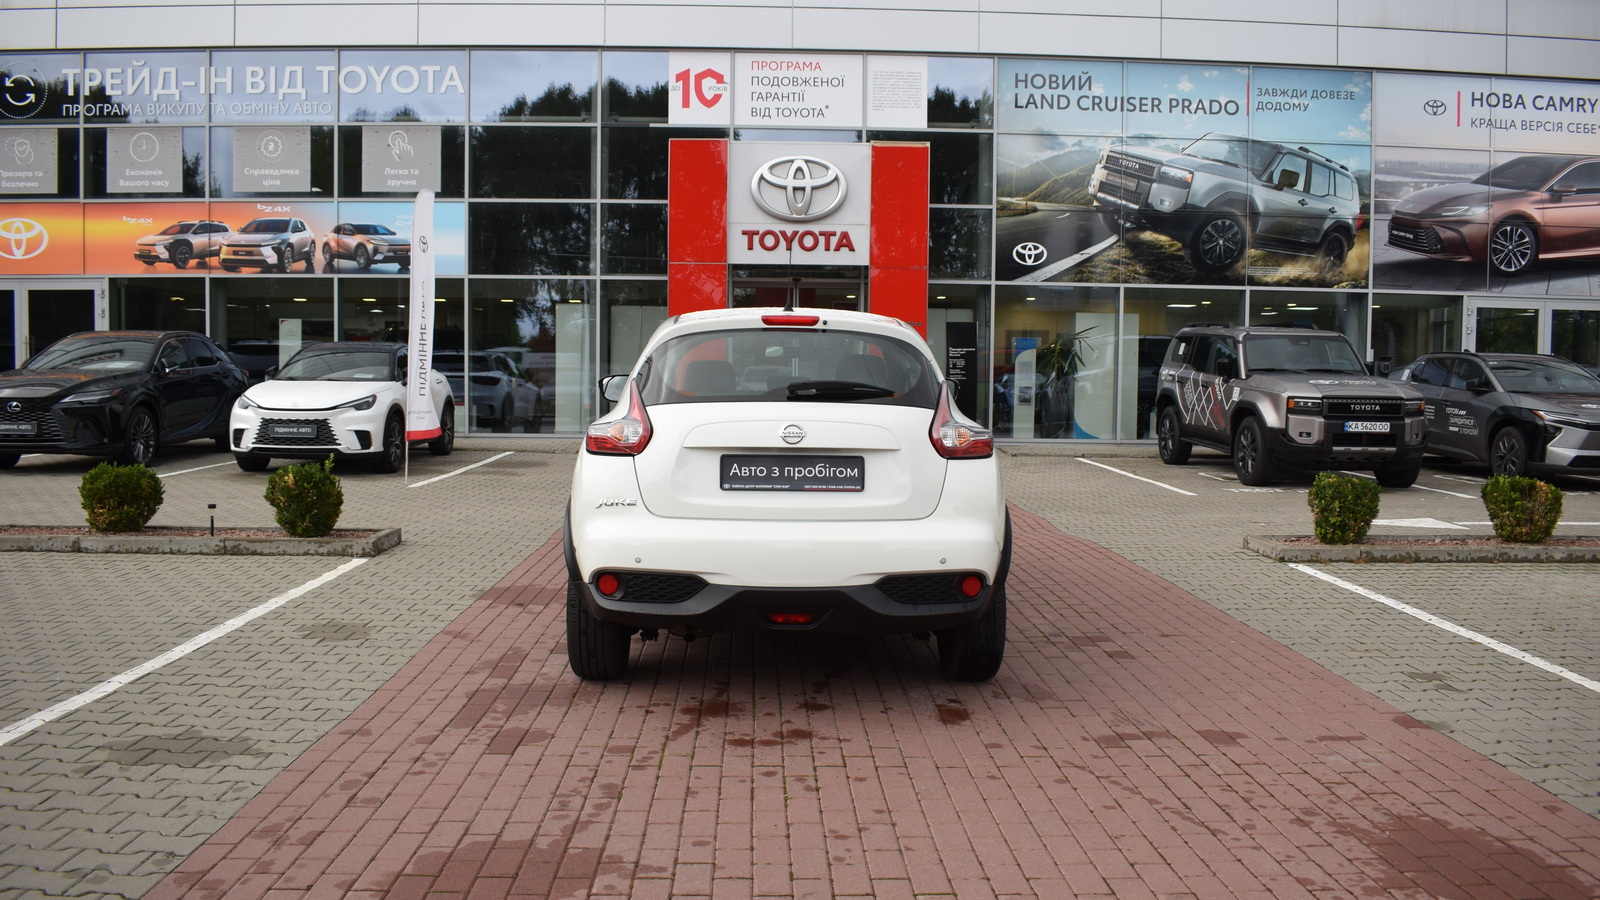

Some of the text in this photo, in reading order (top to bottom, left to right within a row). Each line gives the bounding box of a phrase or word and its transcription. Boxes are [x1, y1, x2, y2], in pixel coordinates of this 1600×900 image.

[751, 60, 822, 72] ПРОГРАМА
[61, 59, 465, 101] ТРЕЙД-ІН ВІД TOYOTA
[751, 74, 846, 88] ПОДОВЖЕНОЇ
[1014, 71, 1092, 91] НОВИЙ
[751, 89, 806, 102] ГАРАНТІЇ
[1256, 87, 1356, 100] ЗАВЖДИ ДОВЕЗЕ
[1014, 92, 1240, 116] LAND CRUISER PRADO
[1256, 101, 1309, 112] ДОДОМУ
[1471, 91, 1599, 113] НОВА CAMRY
[62, 101, 332, 117] ПРОГРАМА ВИКУПУ ТА ОБМІНУ АВТО
[751, 107, 772, 119] ВІД
[1470, 118, 1517, 131] КРАЩА
[1520, 120, 1563, 133] ВЕРСІЯ
[1120, 159, 1139, 169] TOYOTA
[0, 170, 33, 178] Прозоро
[125, 168, 163, 176] Економія
[244, 168, 300, 177] Справедлива
[384, 167, 407, 176] Легко
[119, 179, 169, 188] Вашого часу
[262, 178, 281, 187] ціна
[386, 179, 417, 187] зручно
[741, 229, 855, 252] TOYOTA
[418, 323, 428, 397] ПІДМІННЕ
[1348, 422, 1359, 430] KA
[1361, 422, 1377, 430] 5620
[729, 463, 858, 480] Авто з пробігом
[595, 498, 638, 509] JUKE
